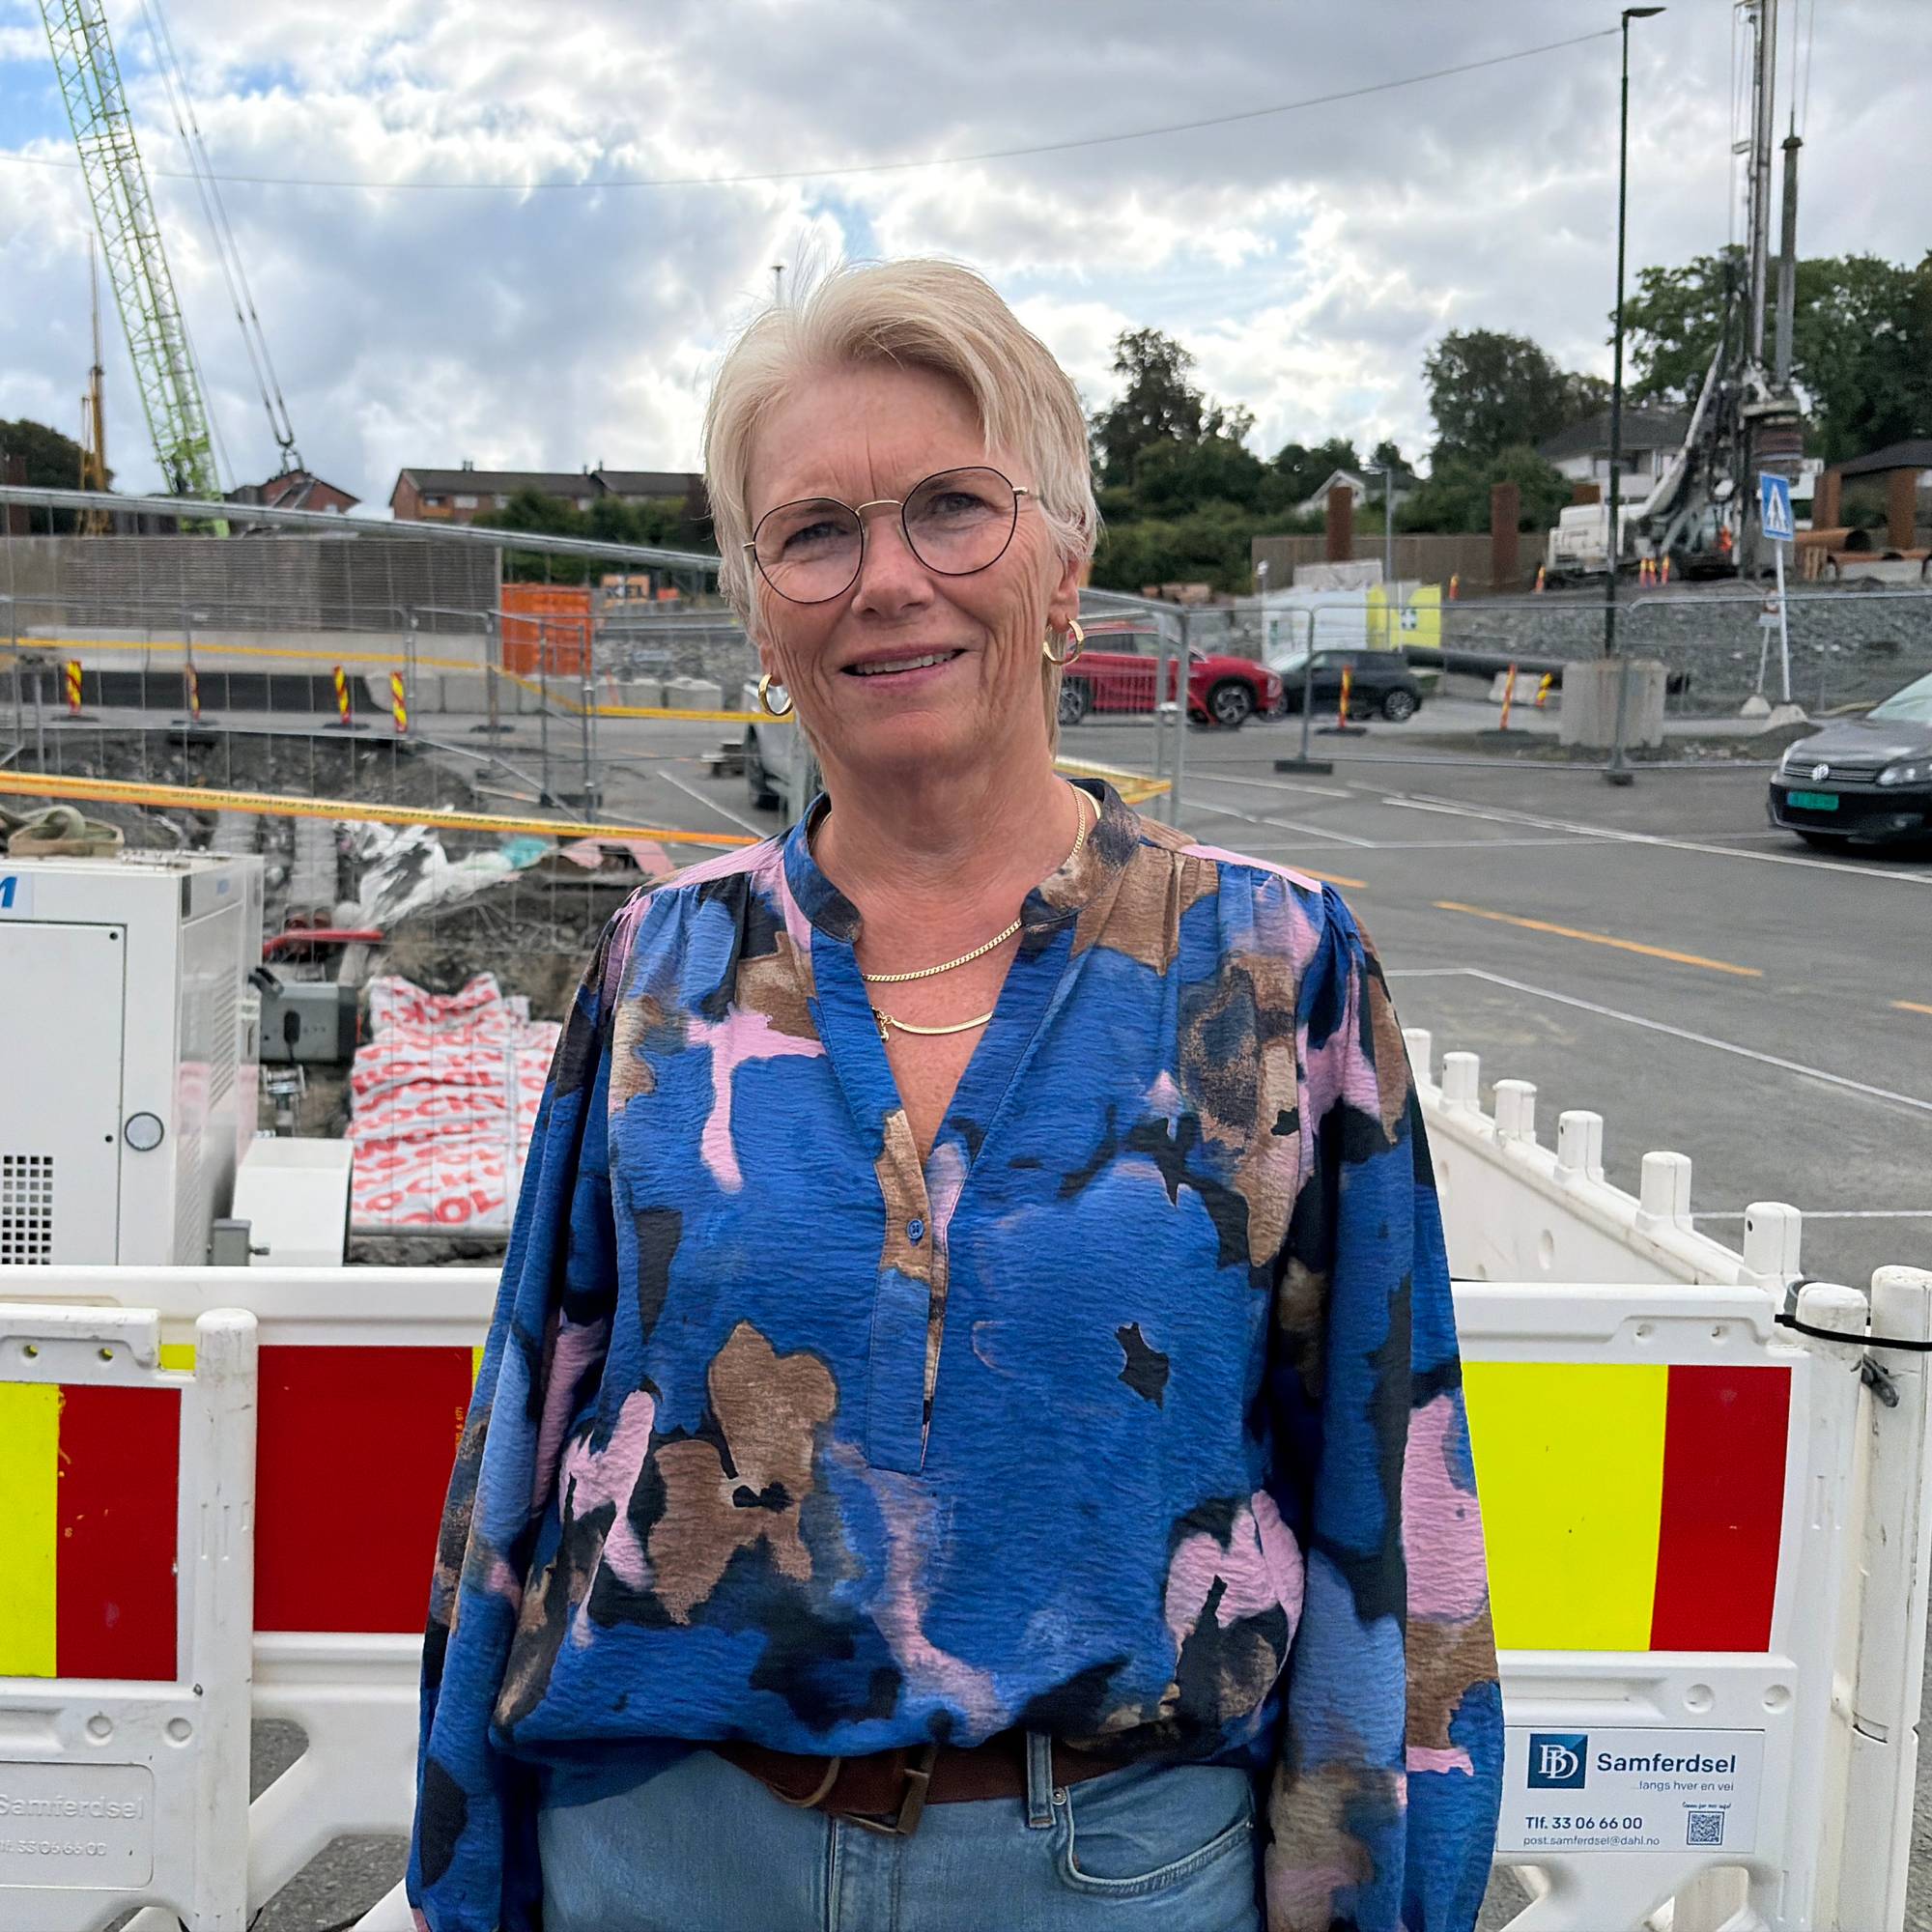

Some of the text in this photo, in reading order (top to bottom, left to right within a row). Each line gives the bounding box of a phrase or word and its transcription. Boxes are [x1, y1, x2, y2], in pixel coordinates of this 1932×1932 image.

[1597, 1752, 1736, 1773] Samferdsel
[1673, 1780, 1698, 1791] hver
[1700, 1782, 1715, 1791] en
[1718, 1782, 1734, 1791] vei
[0, 1793, 144, 1819] Samferdsel
[1525, 1816, 1642, 1830] Tlf. 33 06 66 00
[1523, 1835, 1661, 1846] post.samferdsel@dahl.no
